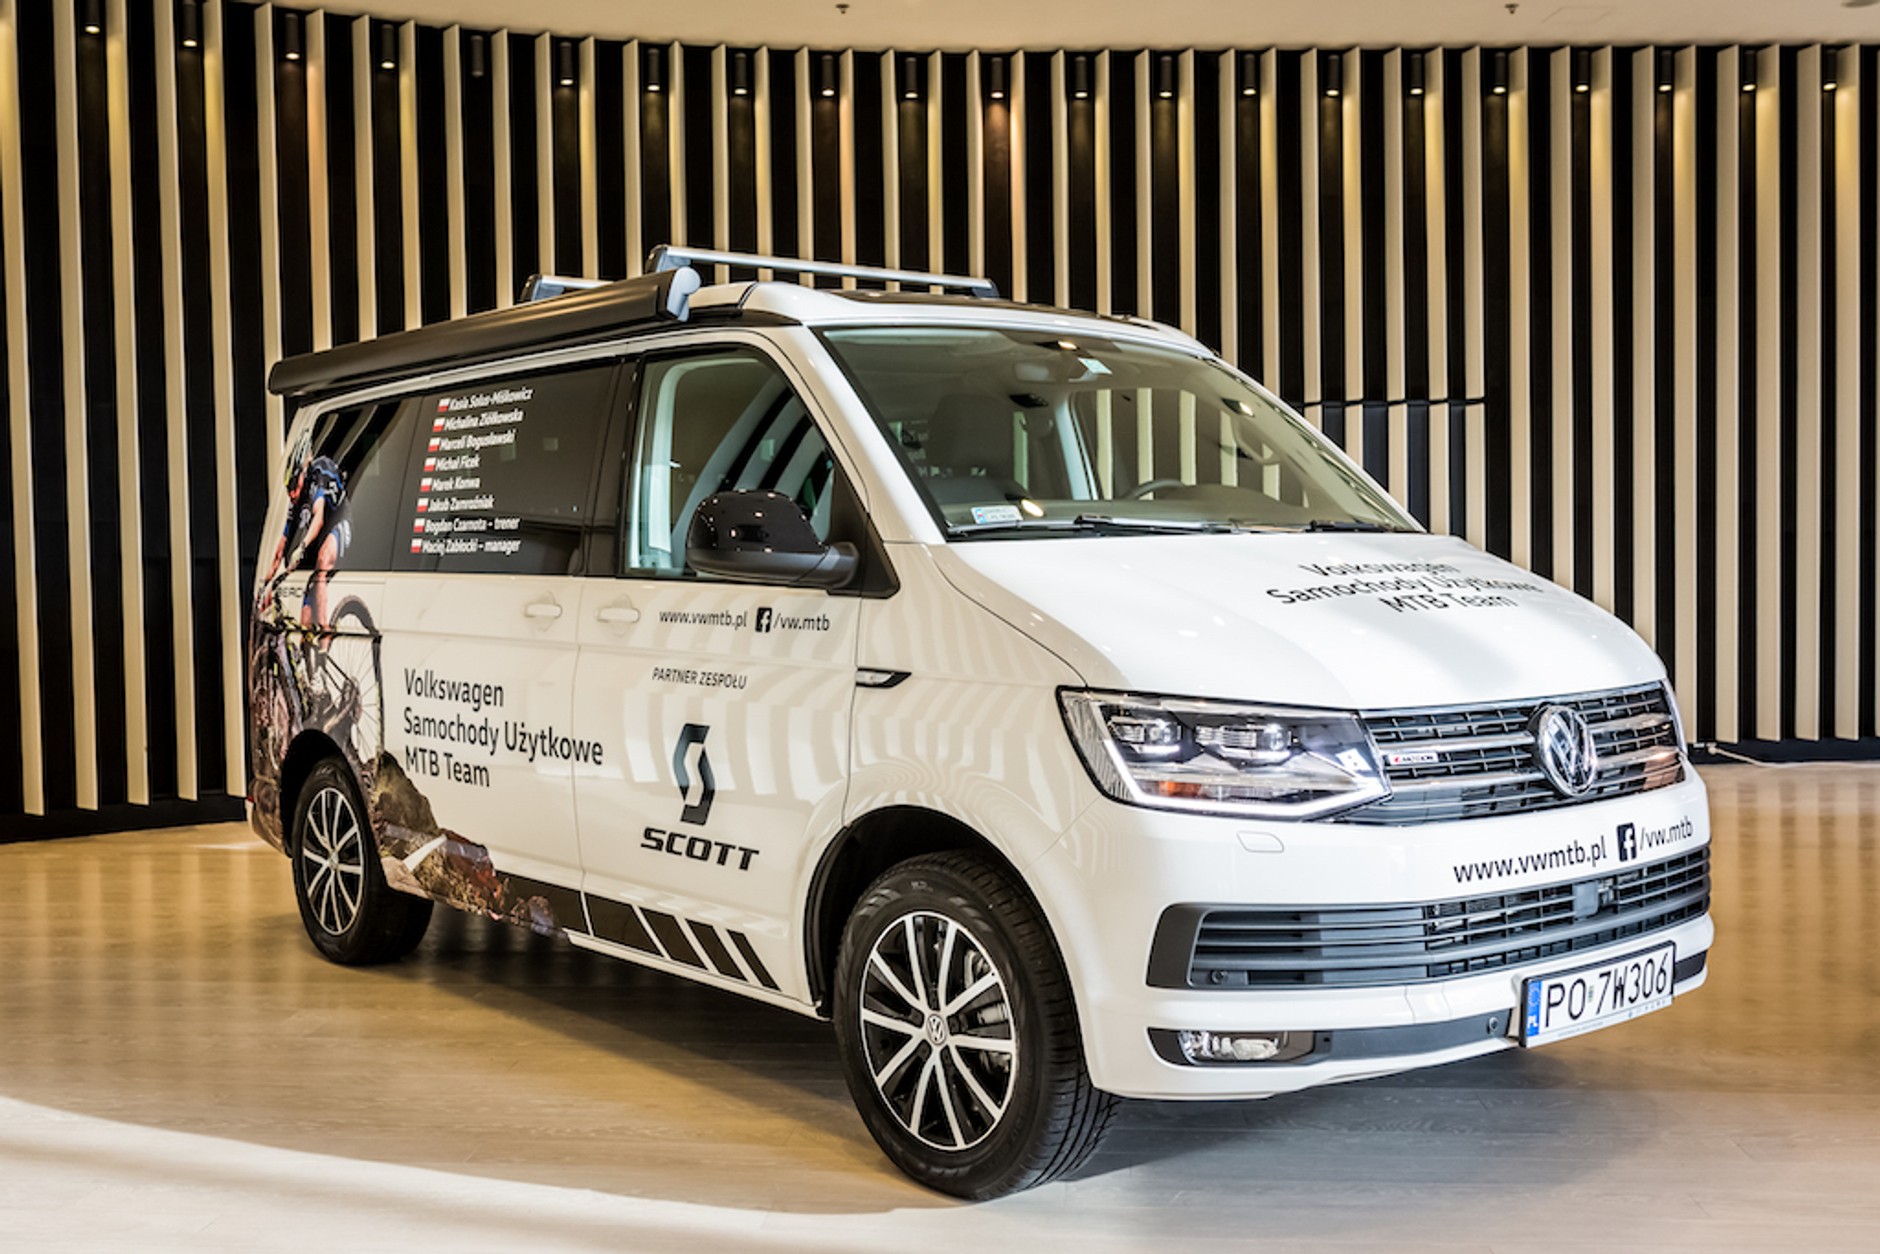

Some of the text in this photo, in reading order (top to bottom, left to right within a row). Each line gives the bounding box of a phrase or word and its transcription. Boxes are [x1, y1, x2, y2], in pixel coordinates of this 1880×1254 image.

[448, 396, 468, 411] Kasia
[444, 414, 478, 430] Michalina
[440, 435, 466, 451] Marceli
[460, 454, 480, 468] Ficek
[432, 476, 454, 492] Marek
[428, 498, 450, 512] Jakub
[425, 518, 452, 536] Bogdan
[454, 517, 487, 532] Czarnota
[494, 517, 520, 530] trener
[422, 538, 446, 556] Maciej
[484, 540, 521, 555] manager
[1298, 562, 1461, 577] Volkswagen
[1266, 576, 1434, 604] Samochody
[1378, 592, 1518, 612] MTB Team
[659, 610, 748, 631] www.vwmtb.pl
[773, 612, 830, 632] /vw.mtb
[652, 666, 748, 690] PARTNER ZESPOŁU
[404, 667, 504, 712] Volkswagen
[404, 706, 604, 766] Samochody Użytkowe
[405, 745, 490, 788] MTB Team
[640, 826, 760, 872] SCOTT
[1453, 835, 1607, 883] www.vwmtb.pl
[1639, 815, 1694, 851] /vw.mtb
[1544, 952, 1669, 1028] PO 7W306
